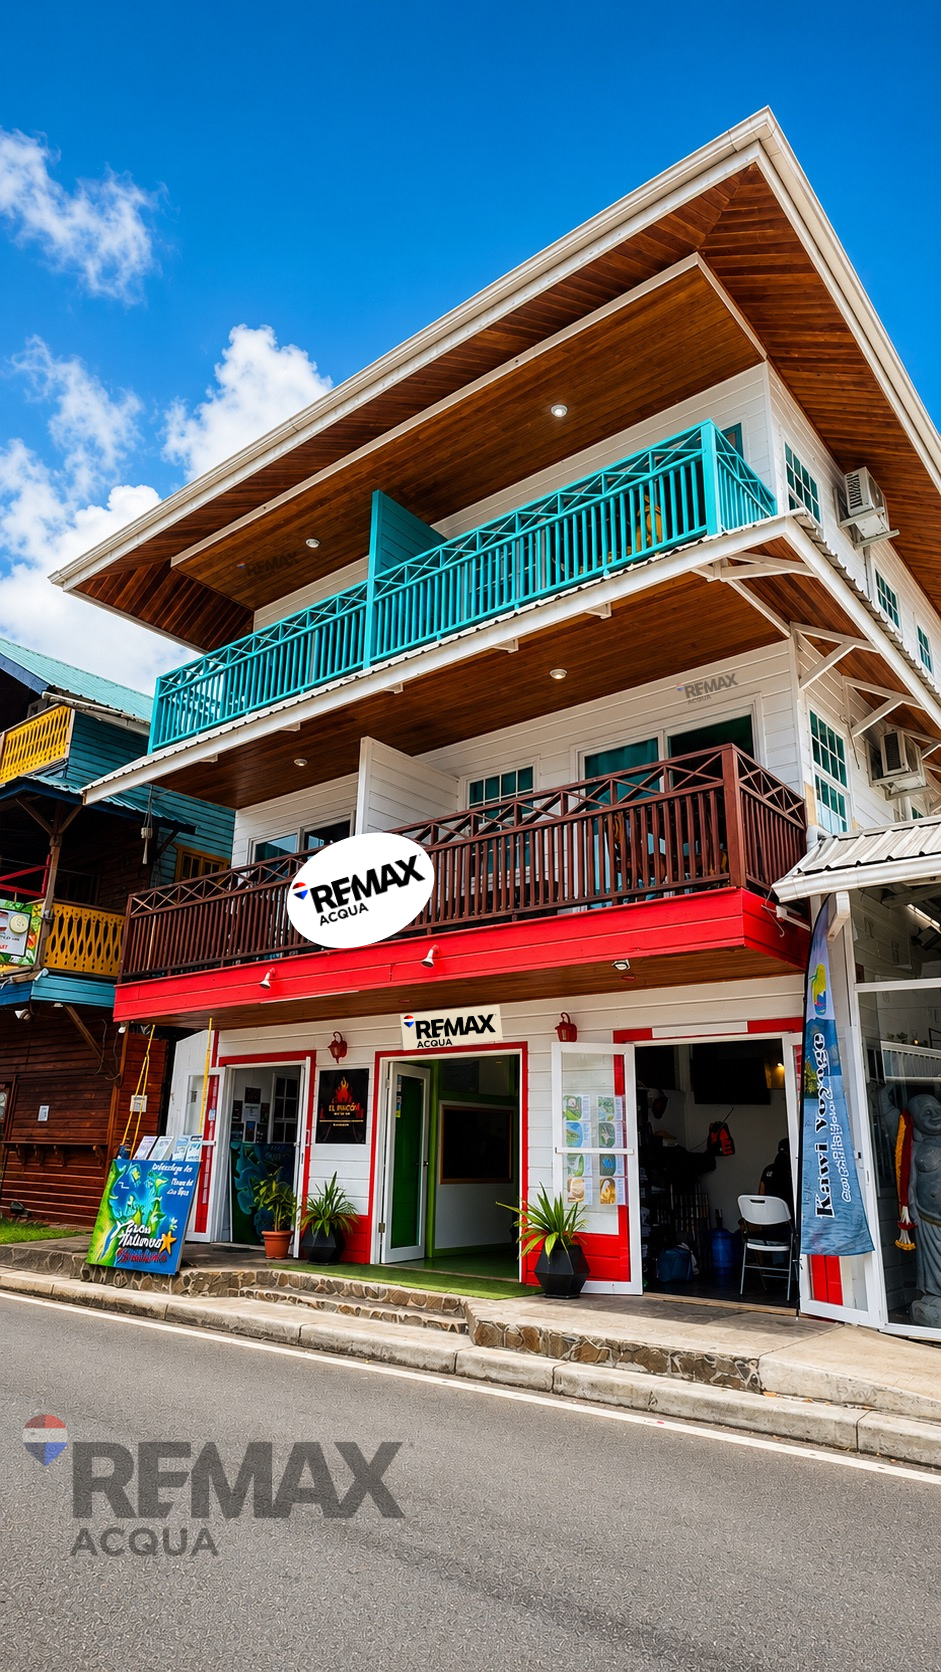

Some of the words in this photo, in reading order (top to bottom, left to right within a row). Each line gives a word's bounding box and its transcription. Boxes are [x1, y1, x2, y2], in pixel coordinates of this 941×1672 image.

[310, 854, 426, 913] REMAX
[320, 903, 369, 926] ACQUA
[415, 1014, 496, 1039] REMAX
[417, 1038, 453, 1048] ACQUA
